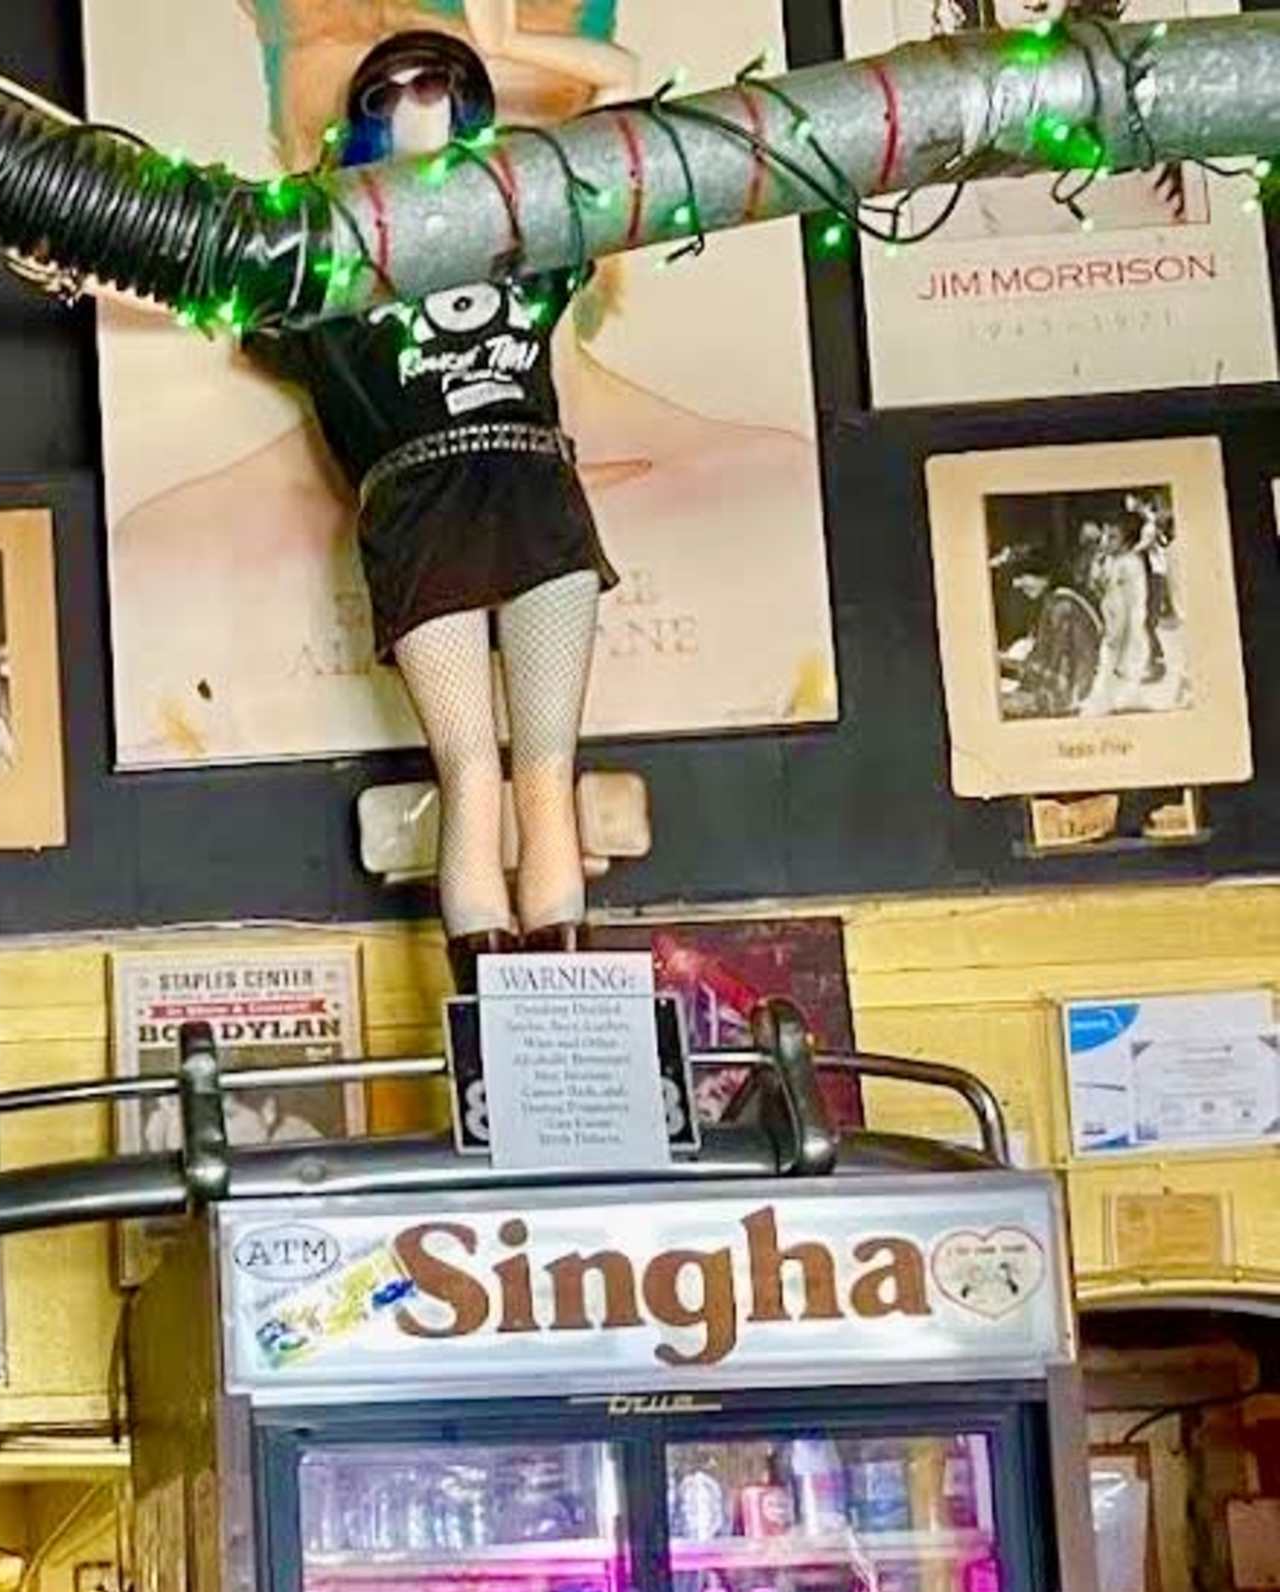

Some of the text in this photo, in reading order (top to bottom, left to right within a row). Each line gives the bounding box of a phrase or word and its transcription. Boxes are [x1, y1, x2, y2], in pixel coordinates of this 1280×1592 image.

[918, 254, 1217, 301] JIM MORRISON
[158, 967, 313, 992] STAPLES CENTER
[500, 964, 635, 992] WARNING:
[221, 1019, 340, 1040] DYLAN
[247, 1239, 327, 1266] ATM
[393, 1207, 934, 1366] Singha
